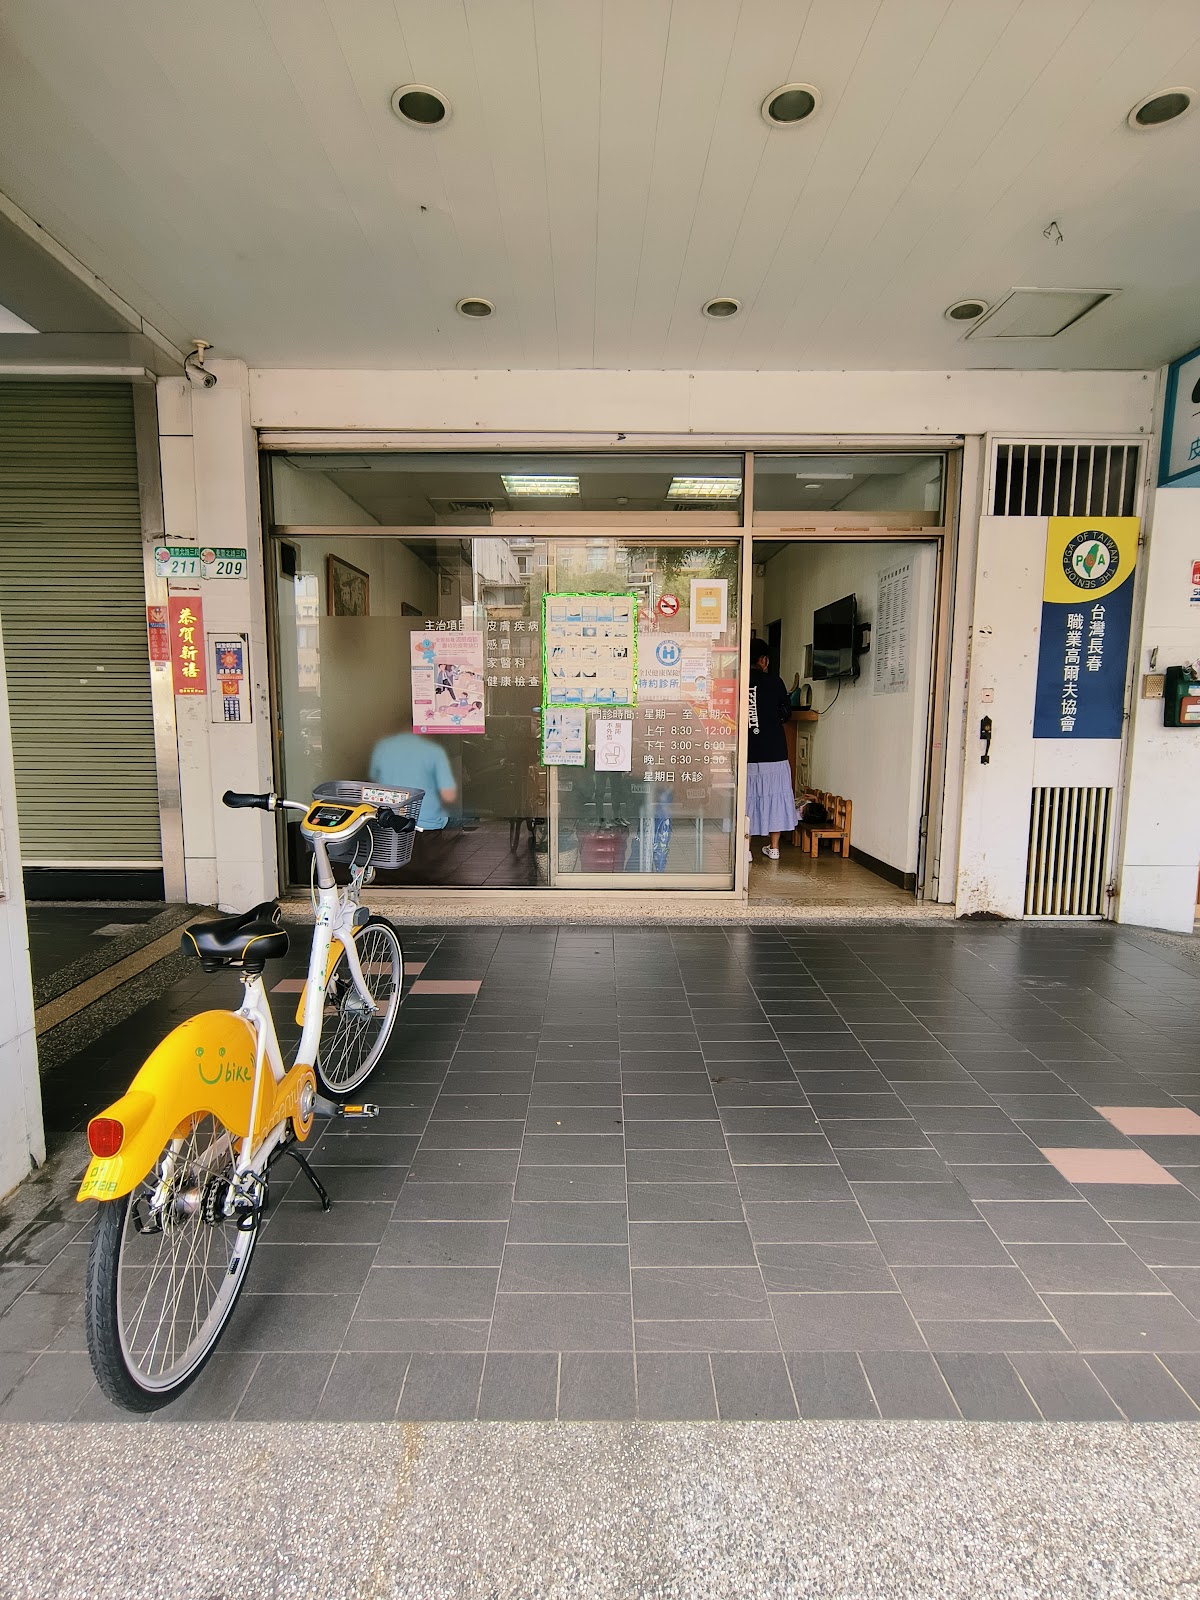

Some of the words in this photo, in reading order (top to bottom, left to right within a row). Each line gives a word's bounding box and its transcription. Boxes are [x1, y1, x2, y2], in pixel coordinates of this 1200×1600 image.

[1077, 532, 1089, 543] OF
[1063, 543, 1076, 563] PGA
[1092, 531, 1118, 563] TAIWAN
[1076, 554, 1106, 567] PGA
[171, 560, 196, 574] 211
[216, 562, 242, 575] 209
[1065, 567, 1096, 588] SENIOR
[1099, 568, 1116, 585] THE
[425, 620, 466, 632] 主治項目
[487, 621, 539, 632] 皮膚疾病
[177, 607, 200, 678] 恭賀新禧
[1086, 604, 1106, 672] 台灣長春
[487, 639, 511, 650] 感冒
[487, 657, 525, 669] 家醫科
[1060, 613, 1084, 732] 職業高爾夫協會
[487, 675, 540, 687] 健康檢查
[637, 678, 681, 689] 特約診所
[644, 709, 677, 720] 星期一
[682, 709, 693, 720] 至
[698, 709, 731, 720] 星期六
[644, 726, 666, 737] 上午
[670, 726, 692, 736] 8:30
[705, 726, 732, 736] 12:00
[644, 740, 666, 752] 下午
[670, 741, 692, 750] 3:00
[704, 741, 726, 751] 6:00
[643, 755, 666, 766] 晚上
[670, 755, 692, 765] 6:30
[643, 771, 675, 782] 星期日
[681, 771, 704, 782] 休診
